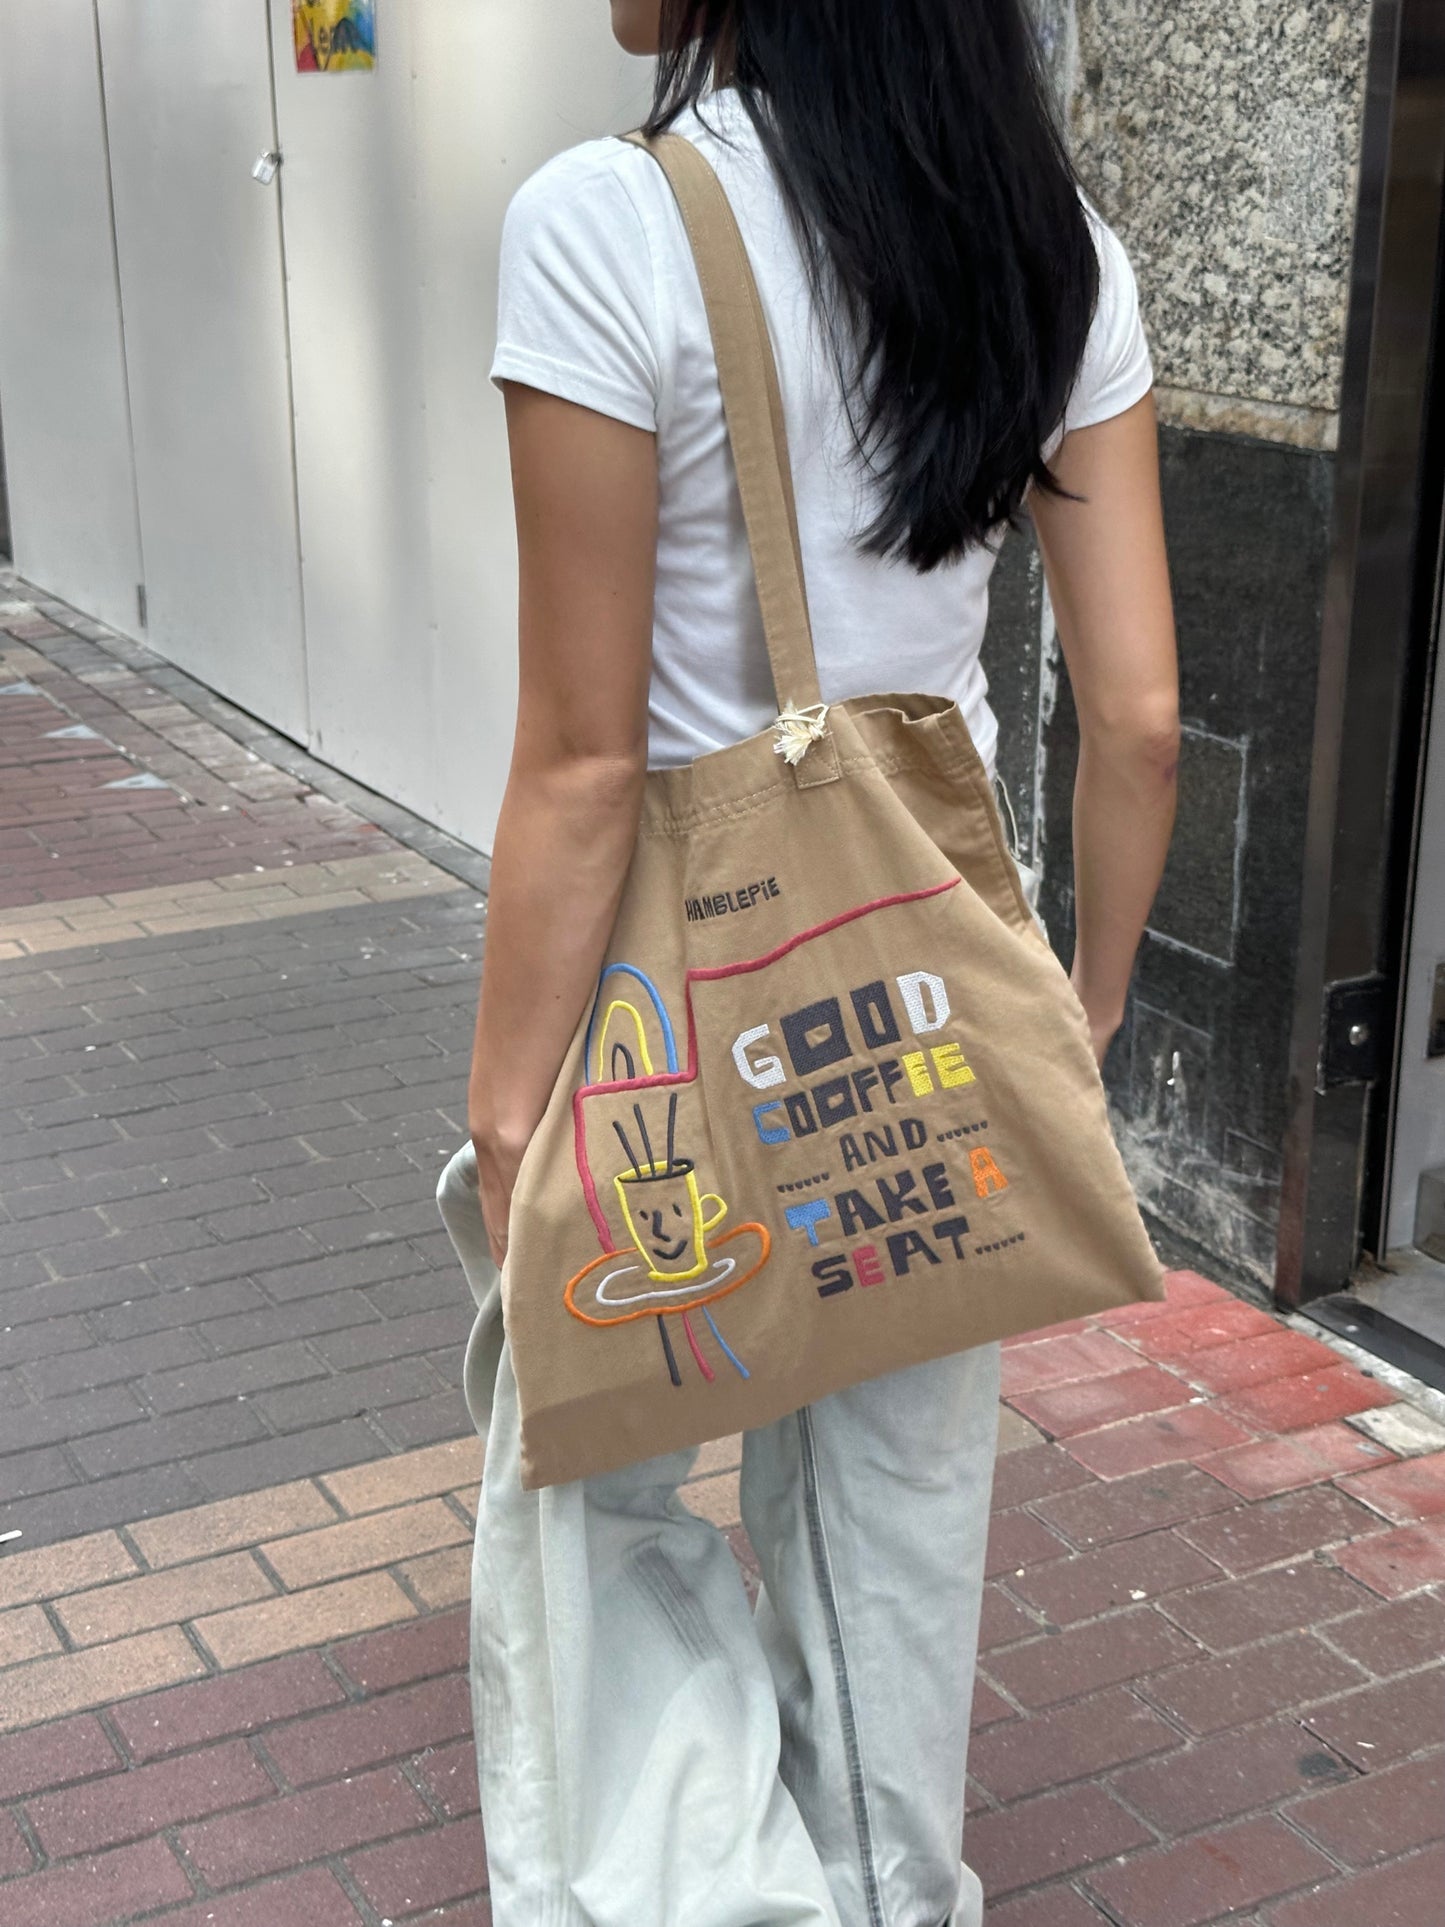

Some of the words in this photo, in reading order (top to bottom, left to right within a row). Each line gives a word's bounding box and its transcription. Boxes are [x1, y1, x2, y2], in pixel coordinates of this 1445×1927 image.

[732, 971, 951, 1089] GOOD
[784, 1162, 956, 1247] TAKE
[968, 1146, 1009, 1199] A
